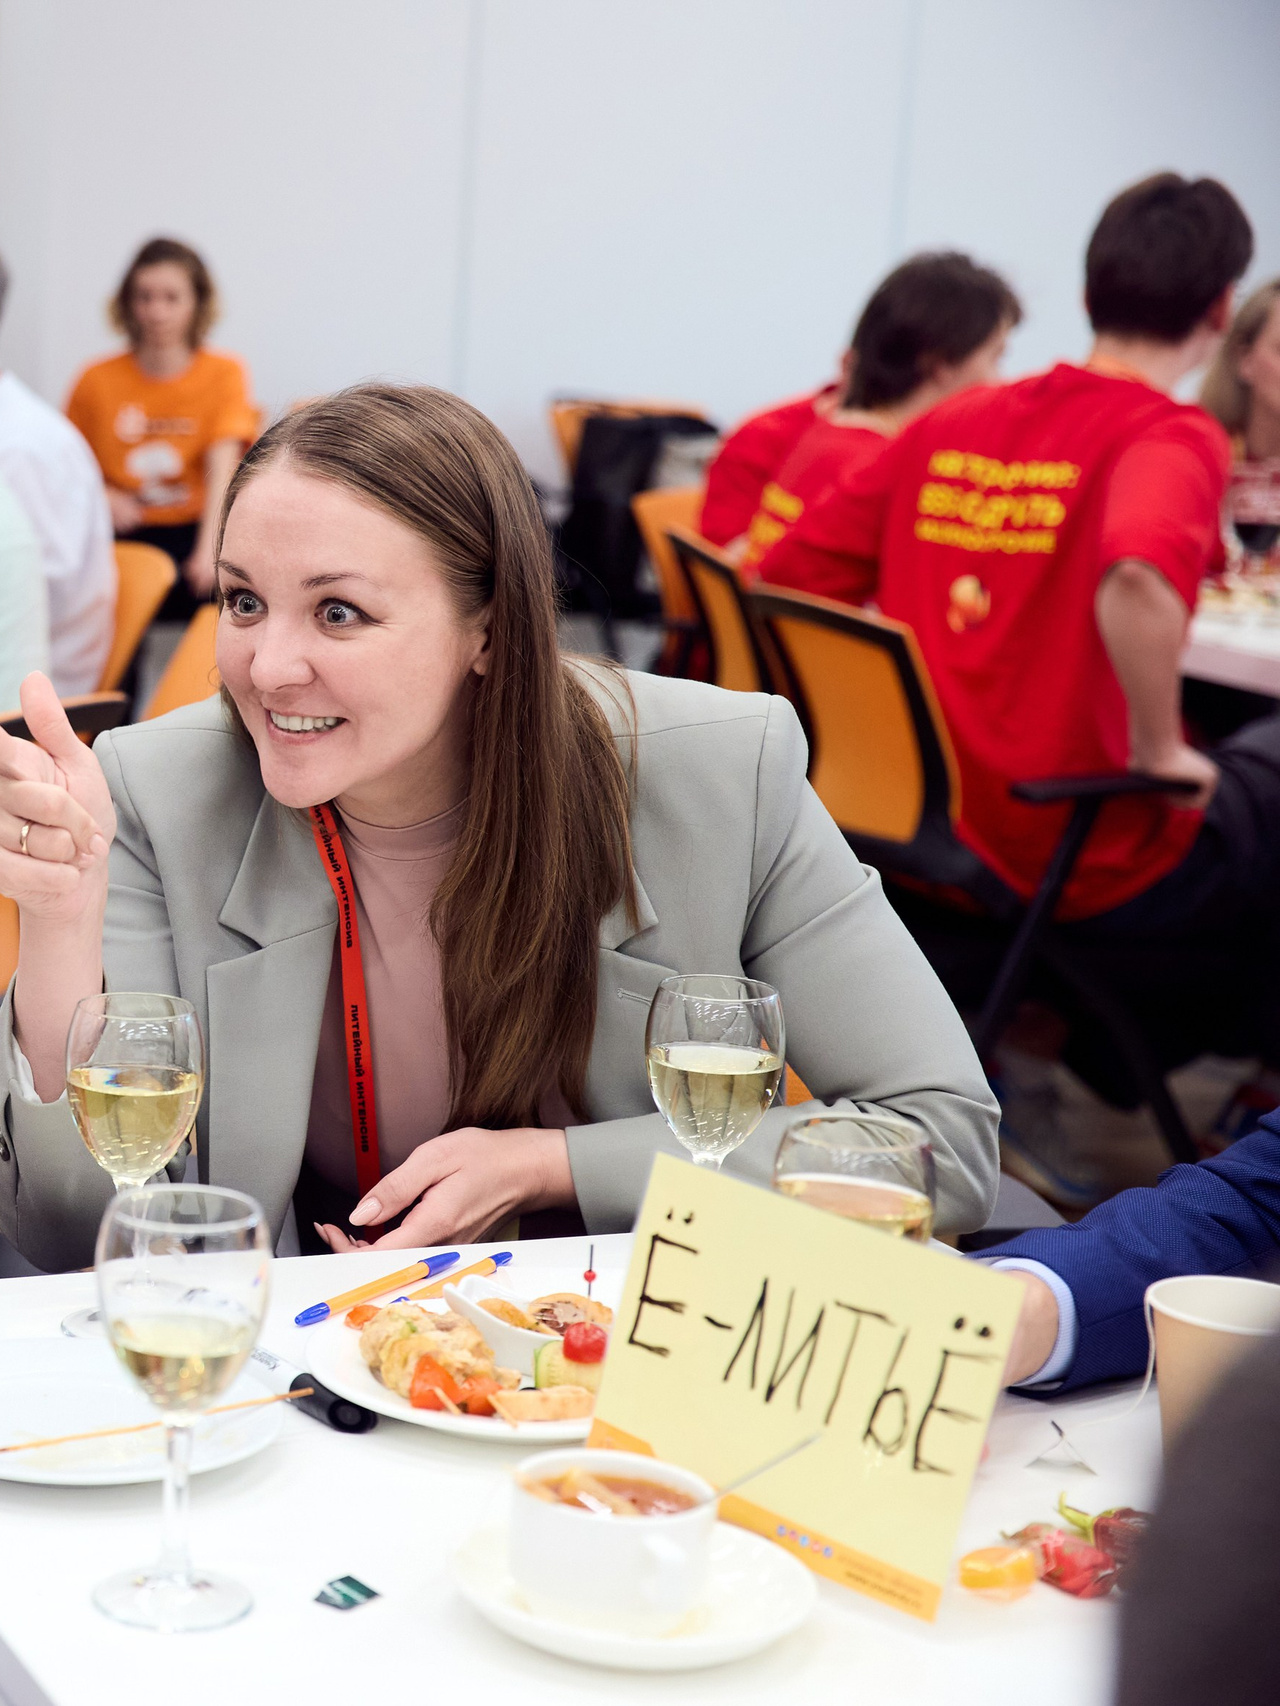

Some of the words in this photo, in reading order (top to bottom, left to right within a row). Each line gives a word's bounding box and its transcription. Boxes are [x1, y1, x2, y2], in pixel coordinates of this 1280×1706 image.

[335, 876, 353, 949] ИНТЕНСИВ
[350, 1004, 365, 1078] ЛИТЕЙНЫЙ
[355, 1081, 370, 1154] ИНТЕНСИВ
